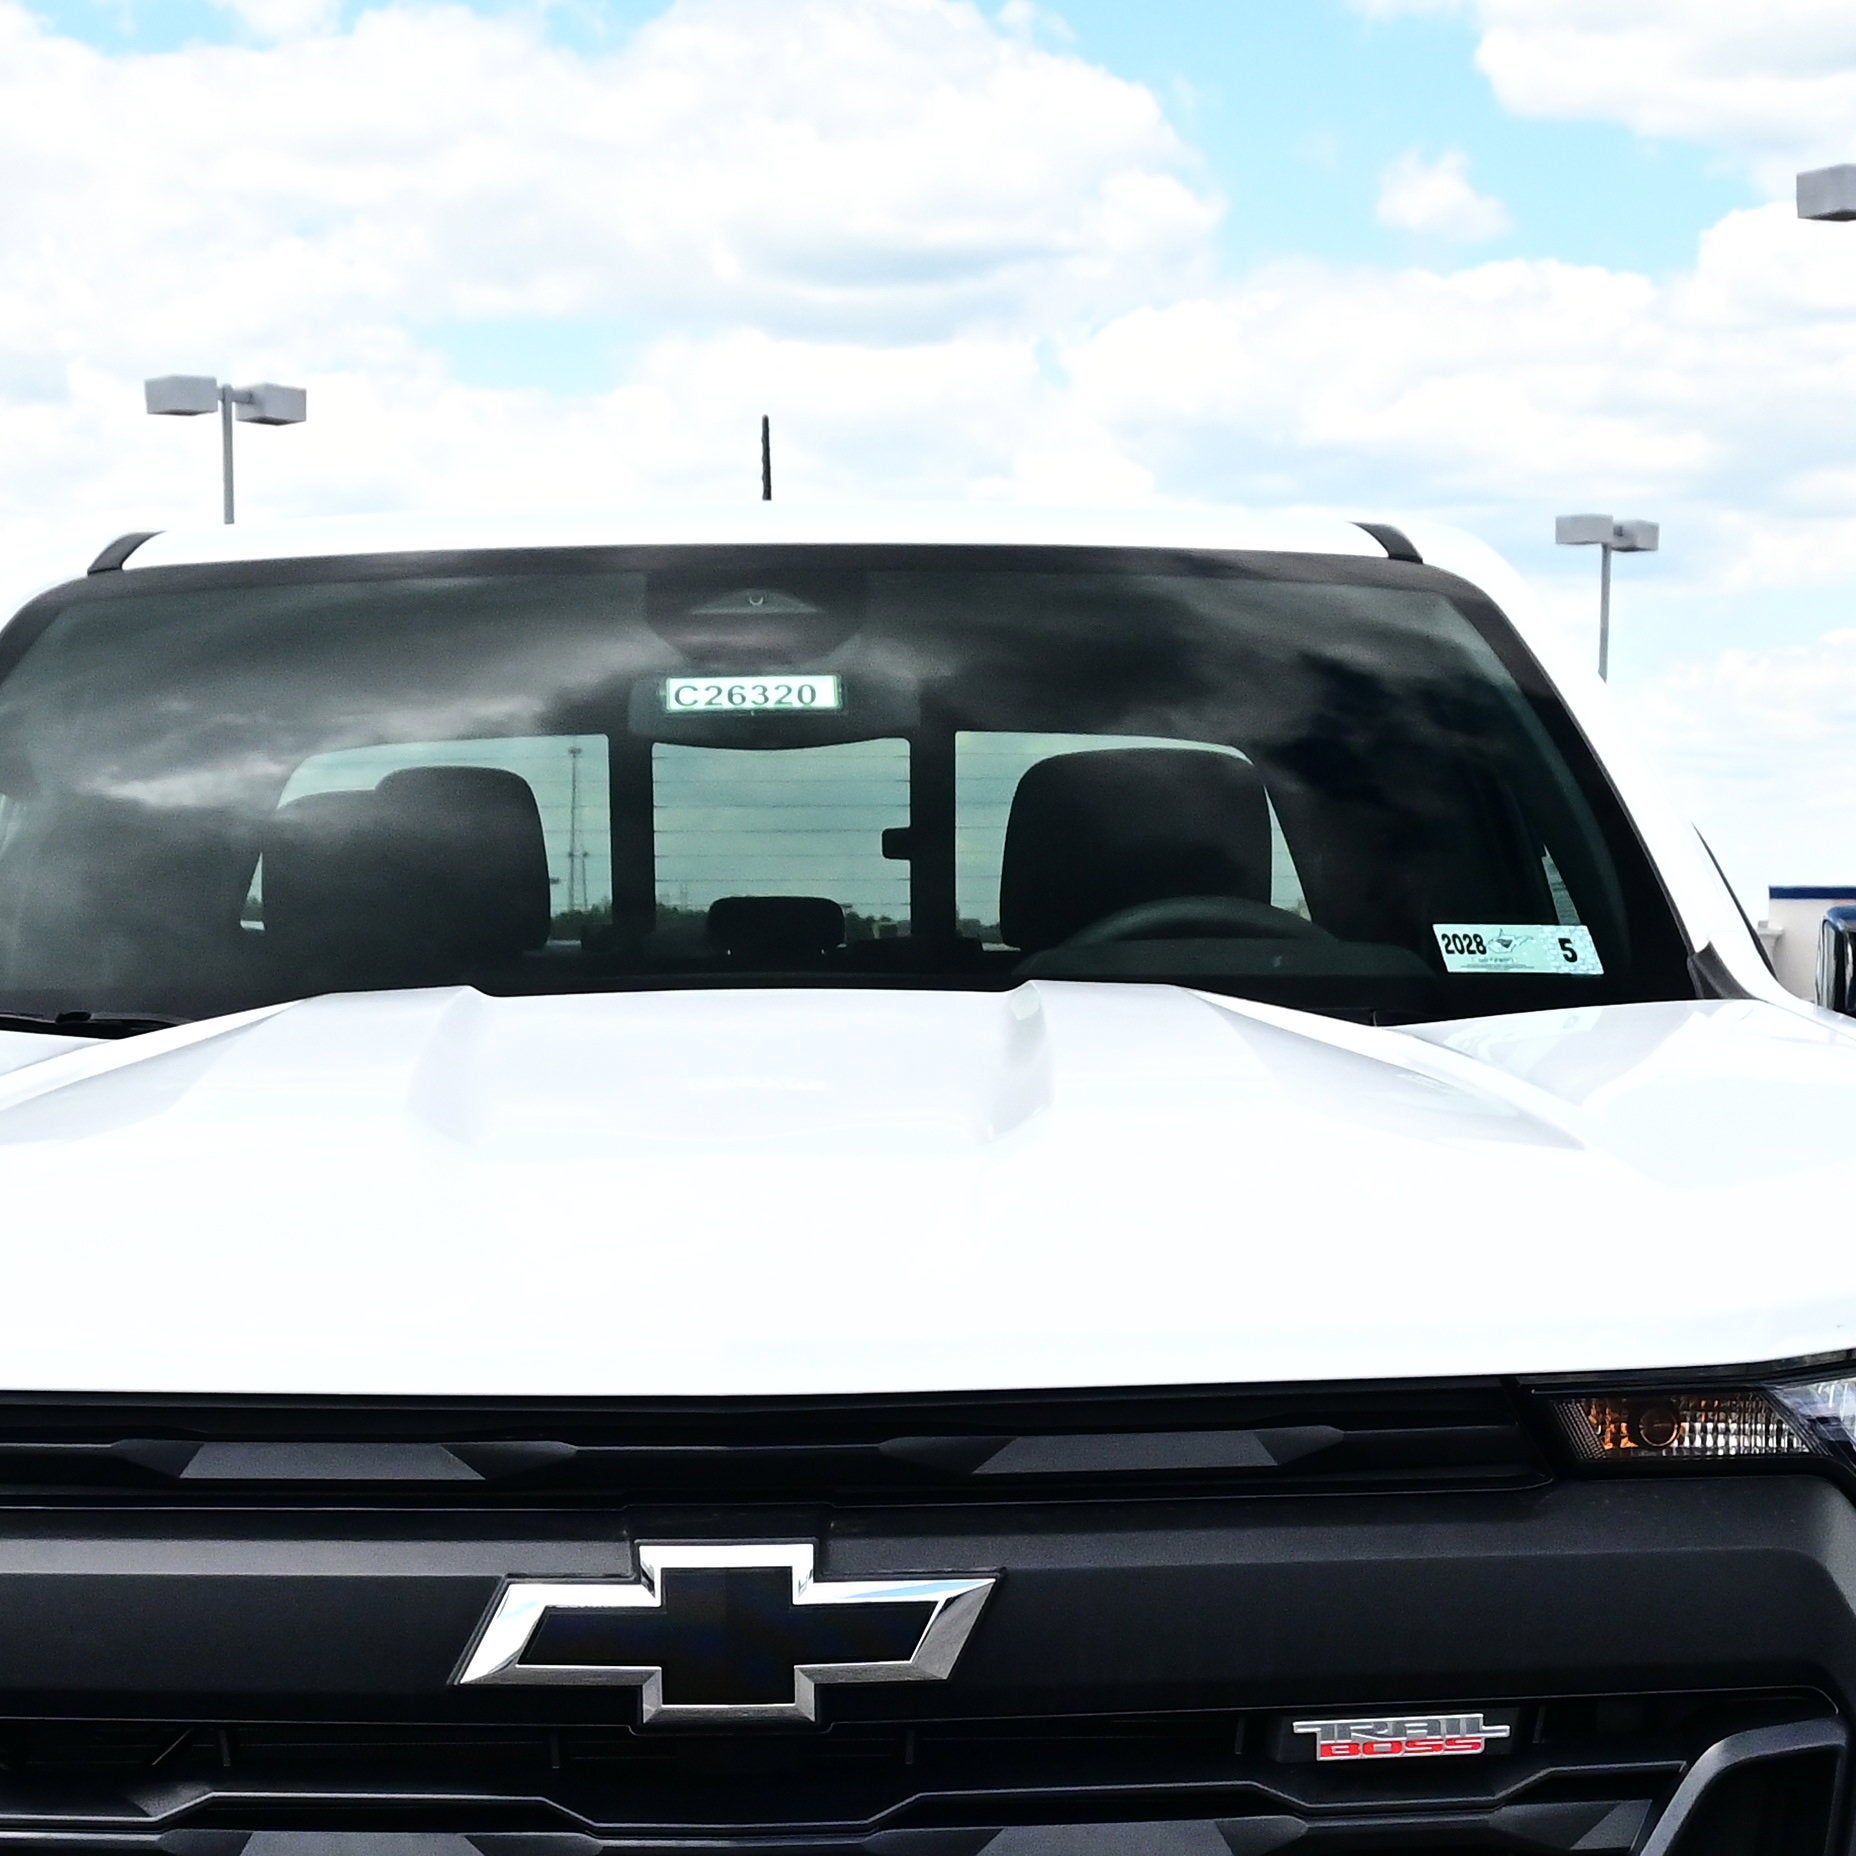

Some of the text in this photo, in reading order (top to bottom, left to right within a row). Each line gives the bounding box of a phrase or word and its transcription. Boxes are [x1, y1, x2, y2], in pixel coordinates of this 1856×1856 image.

[674, 684, 818, 708] C26320
[1441, 933, 1578, 963] 2028 5
[1293, 1713, 1511, 1743] TRAIL
[1317, 1737, 1485, 1761] BOSS
